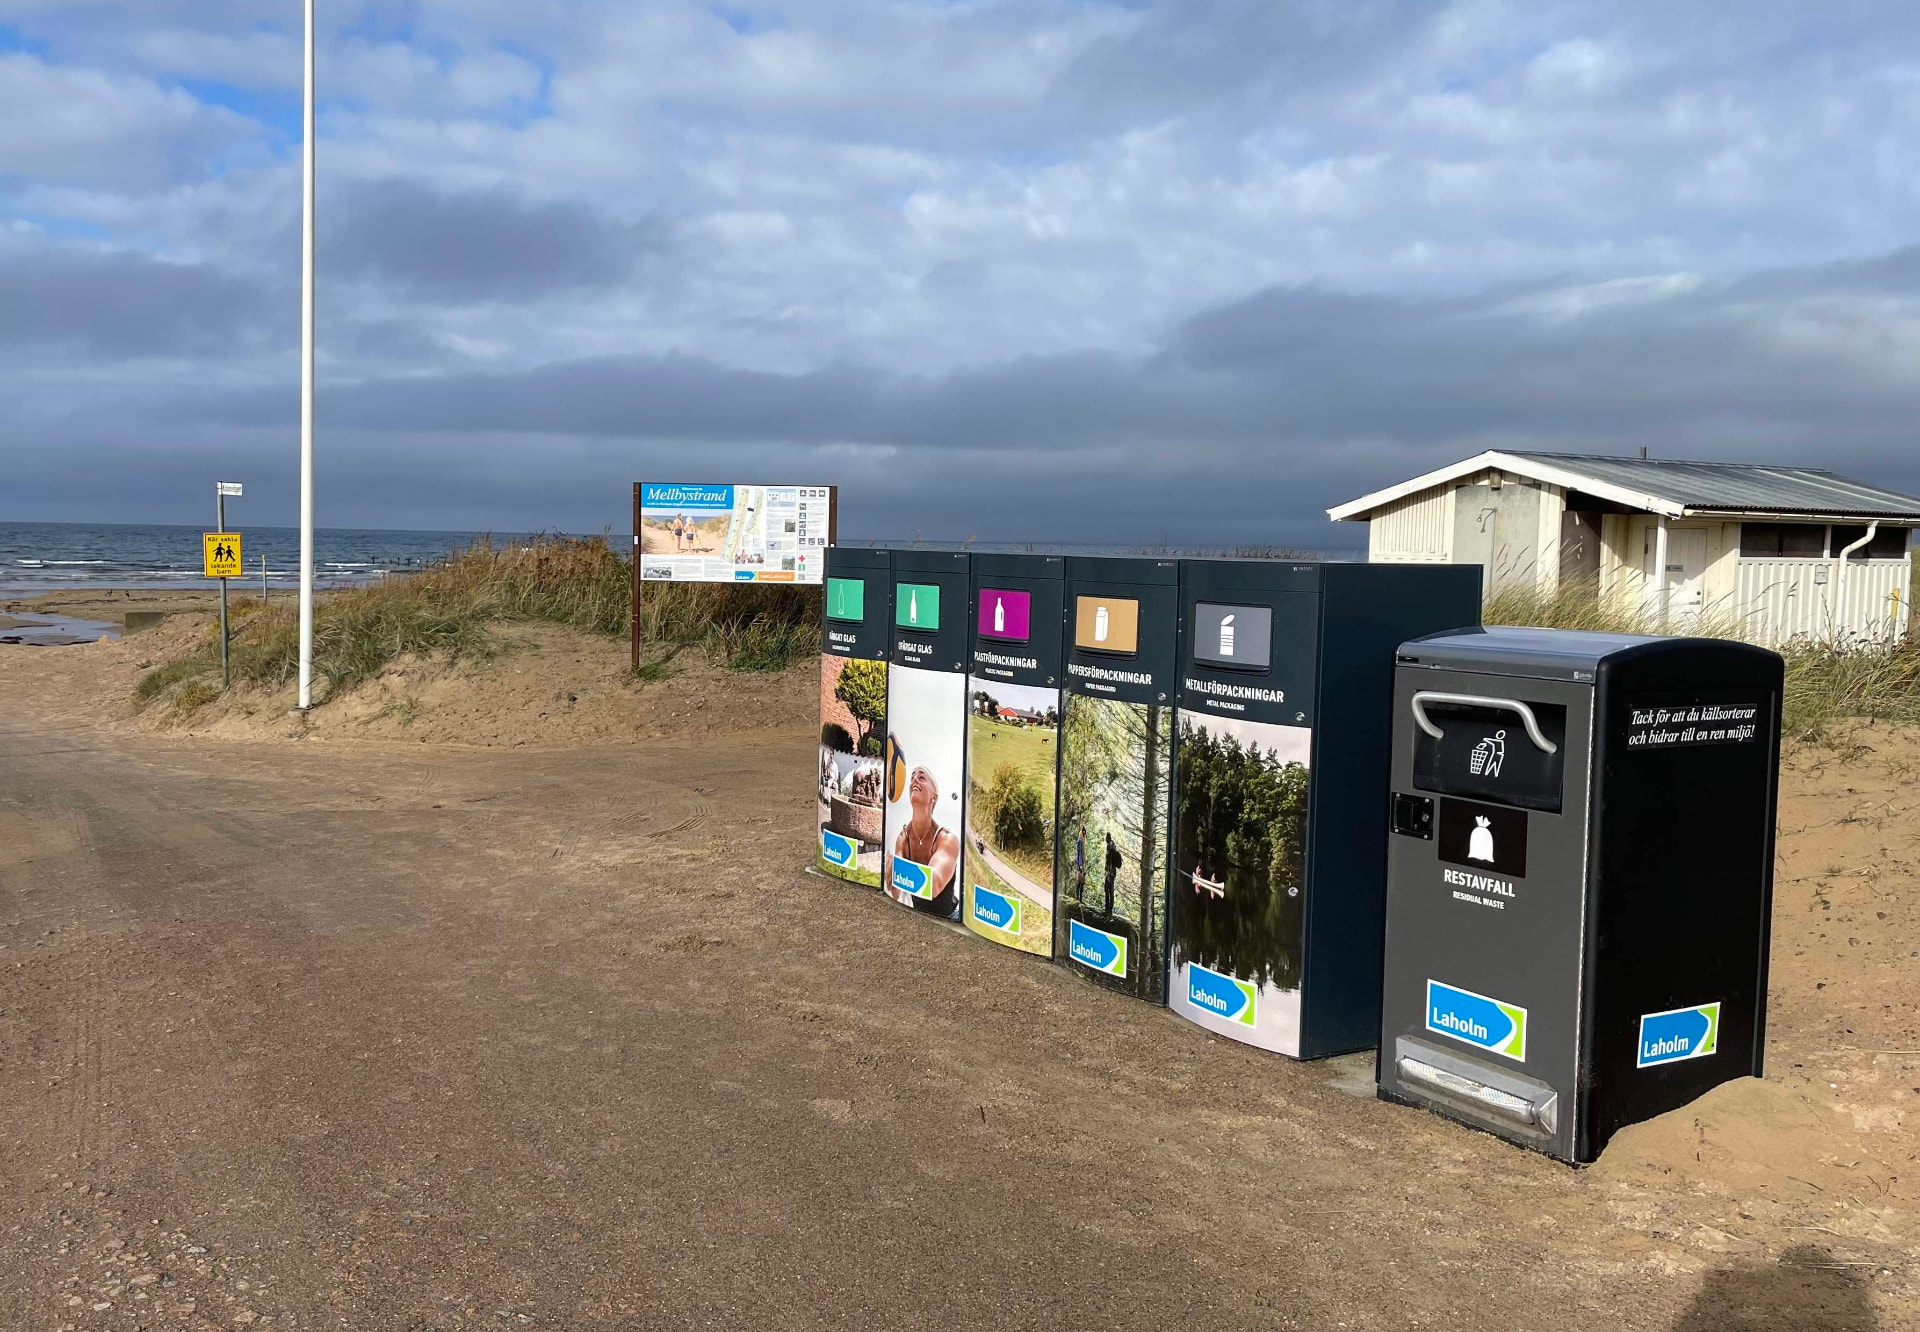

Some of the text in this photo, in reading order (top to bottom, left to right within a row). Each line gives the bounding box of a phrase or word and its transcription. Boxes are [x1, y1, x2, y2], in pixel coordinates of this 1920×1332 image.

[647, 487, 727, 504] Mellbystrand
[843, 633, 857, 644] GLAS
[917, 643, 933, 655] GLAS
[973, 650, 1038, 669] PLASTFÖRPACKNINGAR
[1067, 663, 1153, 685] PAPPERSFÖRPACKNINGAR
[1185, 677, 1285, 703] METALLFÖRPACKNINGAR
[1631, 706, 1756, 728] Tack för att du källsorterar
[1628, 724, 1756, 746] och bidrar till en ren miljö!
[823, 844, 843, 862] Laholm
[893, 870, 915, 889] Laholm
[1444, 868, 1516, 898] RESTAVFALL
[1452, 890, 1505, 910] RESIDUAL WASTE
[975, 902, 1001, 923] Laholm
[1072, 939, 1102, 964] Laholm
[1190, 983, 1228, 1012] Laholm
[1432, 1006, 1489, 1040] Laholm
[1643, 1033, 1690, 1058] Laholm
